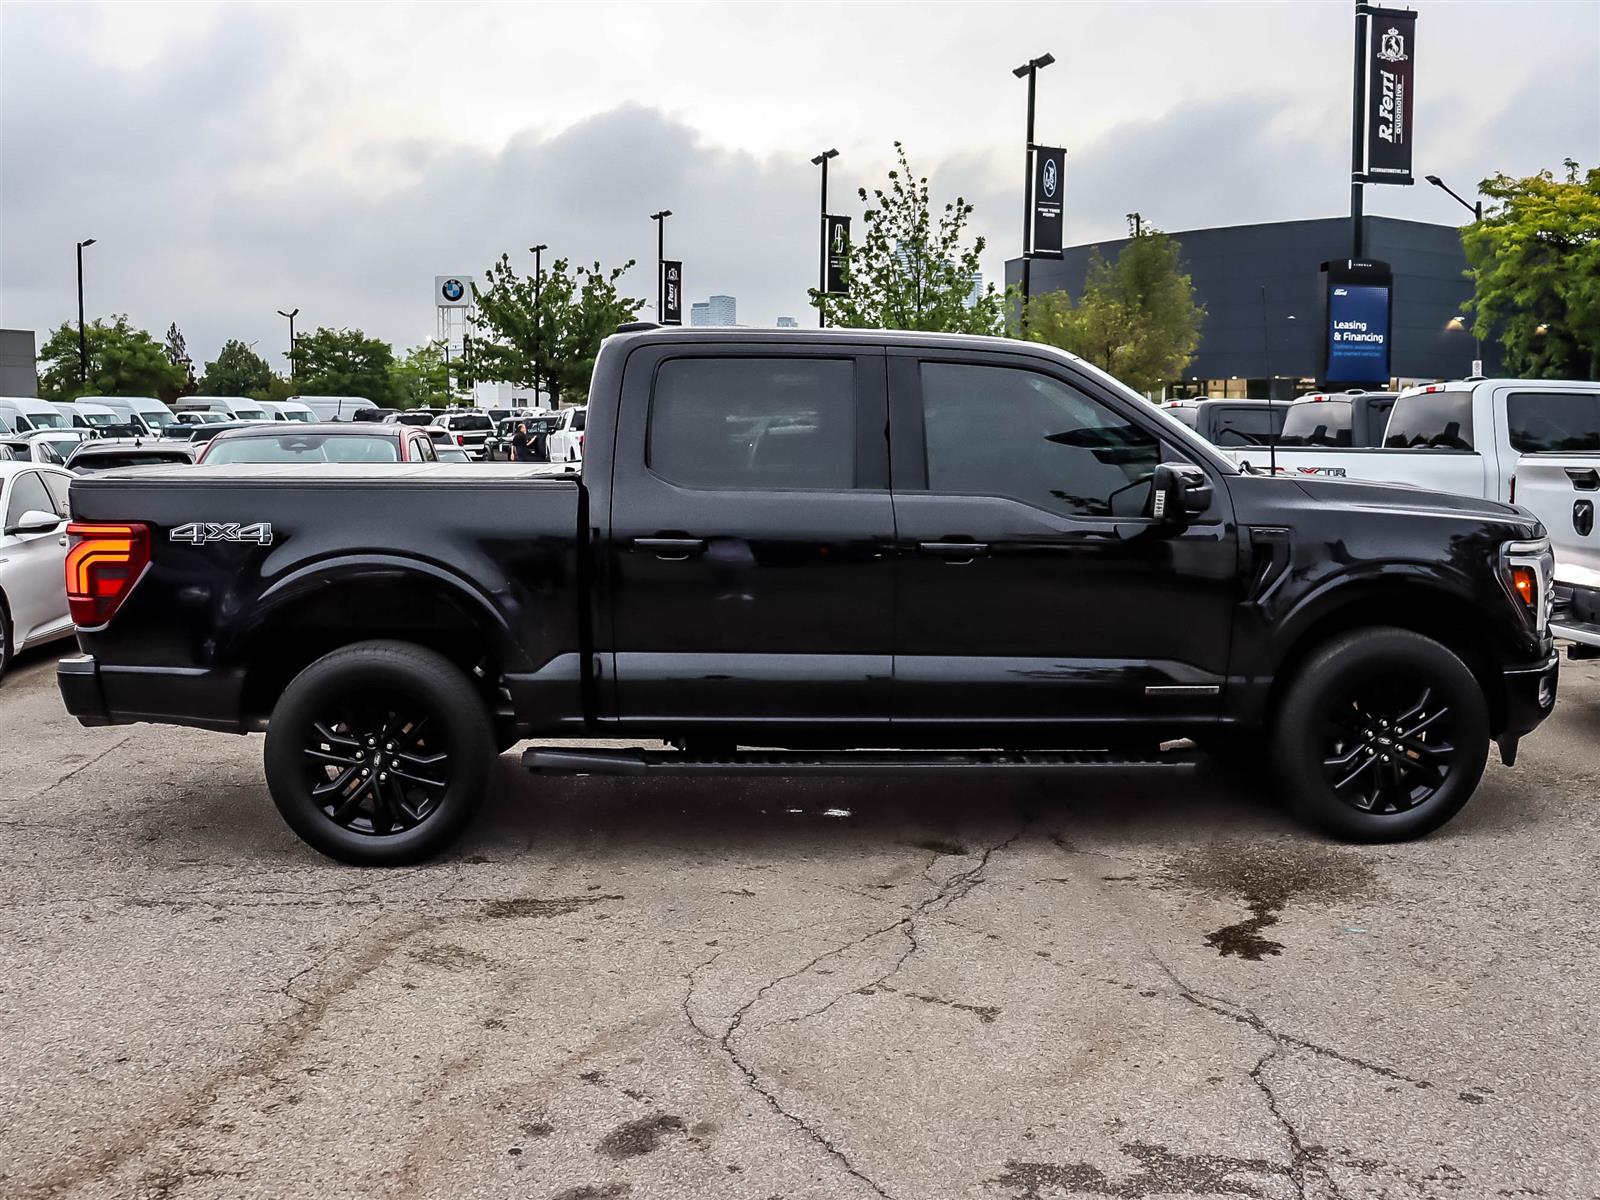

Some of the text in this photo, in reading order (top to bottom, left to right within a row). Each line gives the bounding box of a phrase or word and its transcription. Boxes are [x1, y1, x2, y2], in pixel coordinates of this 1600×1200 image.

[1379, 69, 1394, 122] Ferri
[1045, 166, 1055, 190] Ford
[1333, 320, 1367, 332] Leasing
[1333, 331, 1384, 344] & Financing
